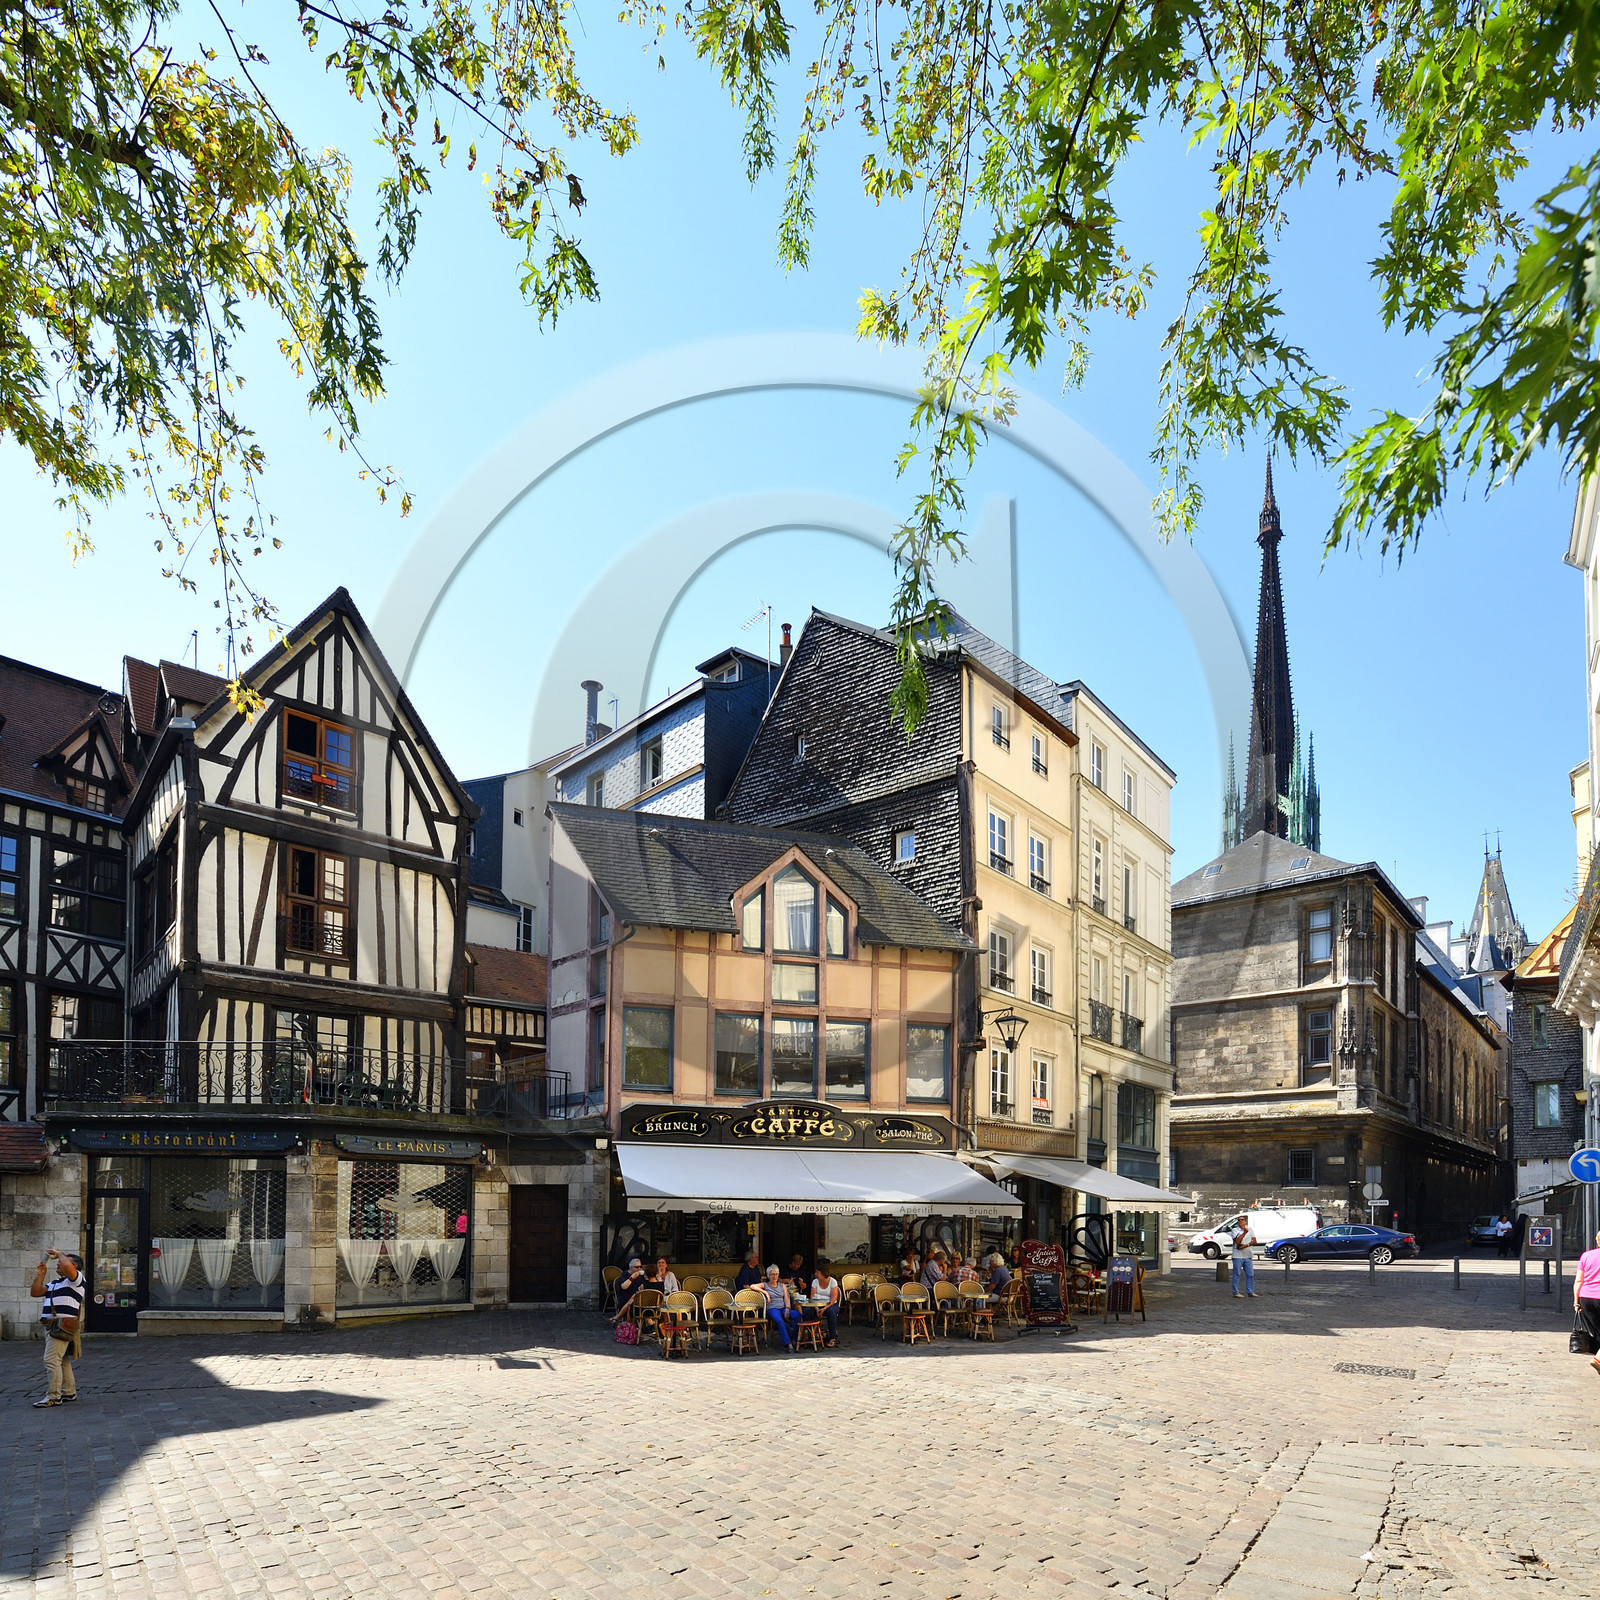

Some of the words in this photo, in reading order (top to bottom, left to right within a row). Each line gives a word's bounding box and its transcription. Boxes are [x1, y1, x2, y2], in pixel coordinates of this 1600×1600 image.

[768, 1108, 820, 1118] ANTICO
[646, 1121, 698, 1132] BRUNCH
[129, 1132, 237, 1146] Restaurant
[881, 1129, 912, 1138] SALON
[378, 1141, 394, 1151] LE
[398, 1142, 446, 1154] PARVIS
[709, 1201, 733, 1211] Café
[774, 1202, 801, 1212] Petite
[805, 1204, 862, 1213] restauration
[900, 1204, 933, 1215] Apéritif
[969, 1206, 997, 1216] Brunch
[1027, 1247, 1056, 1258] Antico
